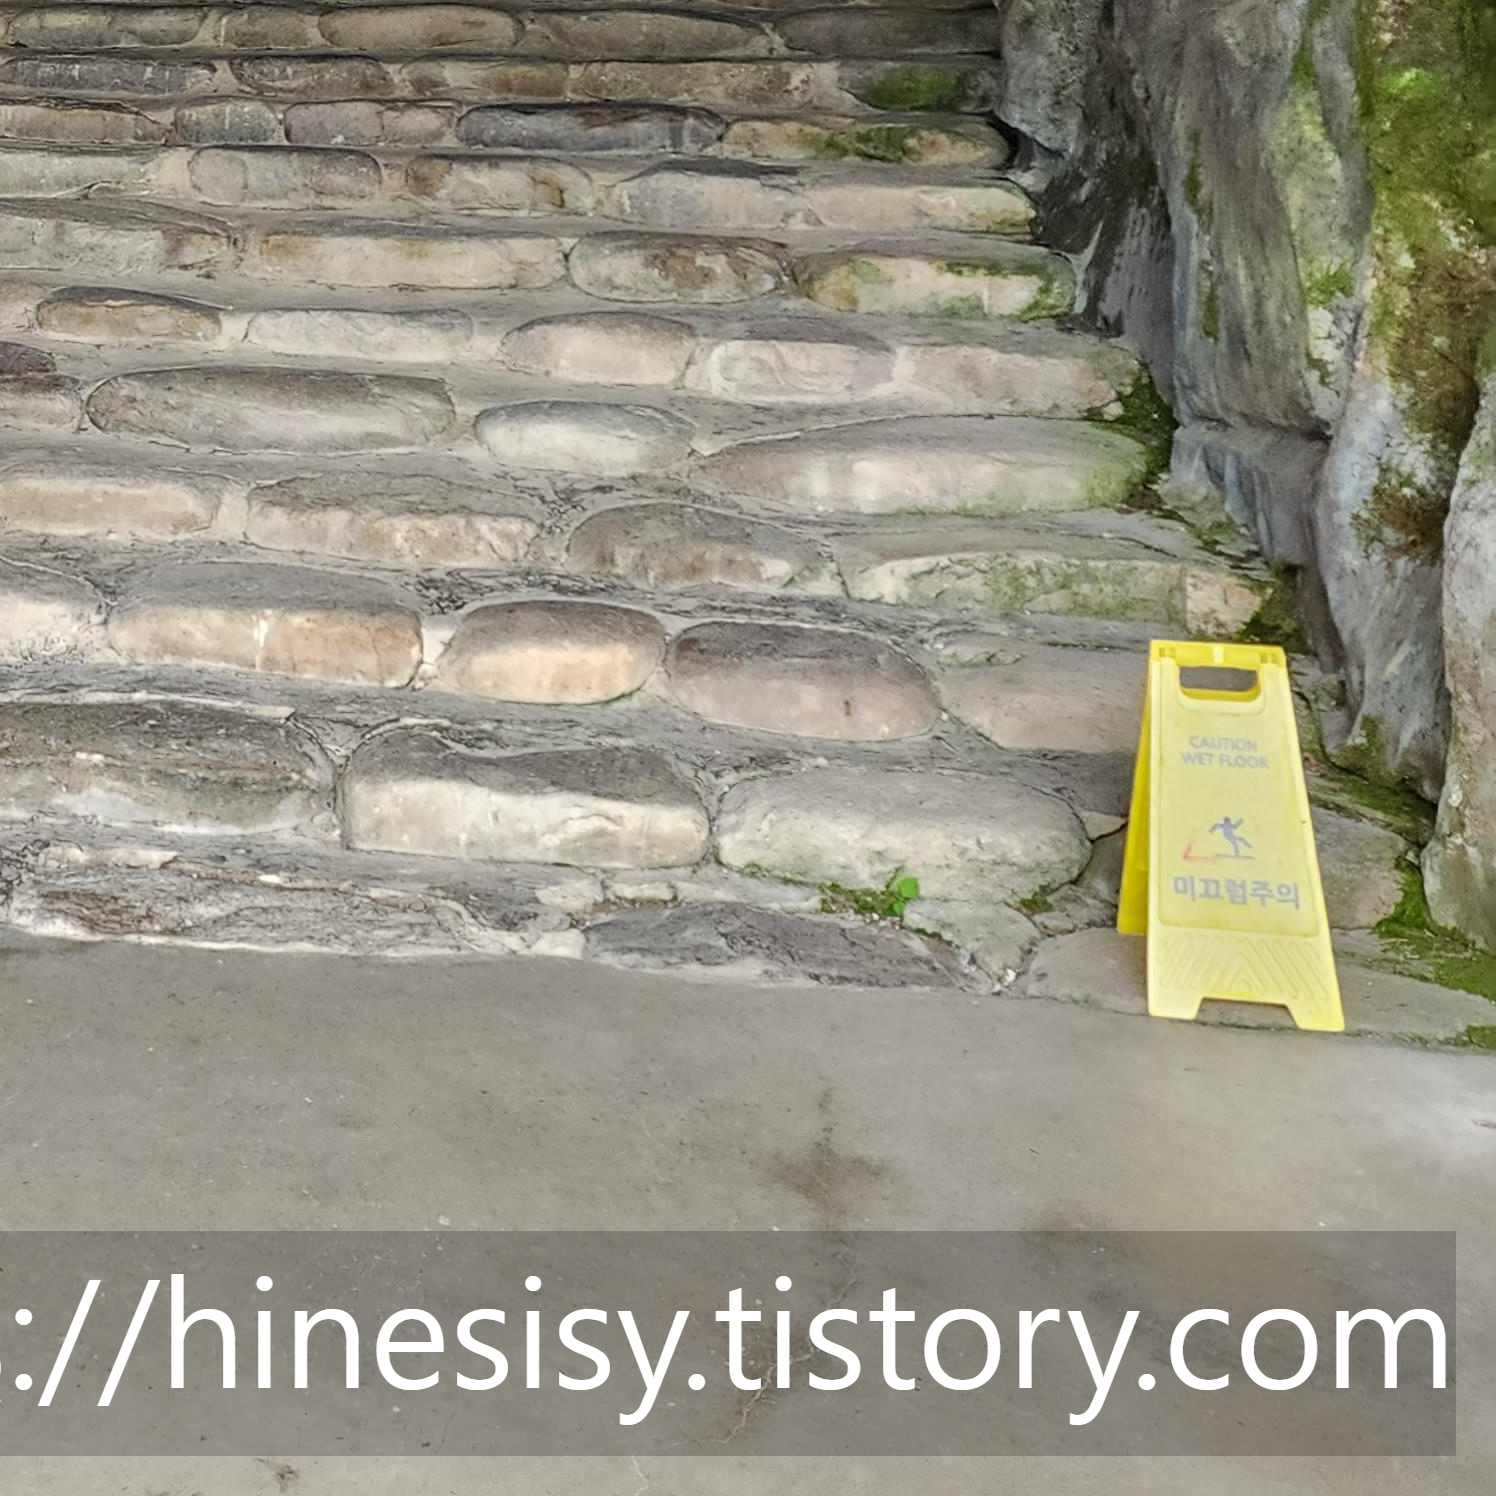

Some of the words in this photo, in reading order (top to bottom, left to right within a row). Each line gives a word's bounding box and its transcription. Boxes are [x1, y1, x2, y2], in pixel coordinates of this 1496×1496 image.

[1188, 735, 1258, 753] CAUTION
[1180, 751, 1214, 766] WET
[1218, 753, 1270, 769] FLOOR
[1173, 875, 1300, 910] 미끄럼주의
